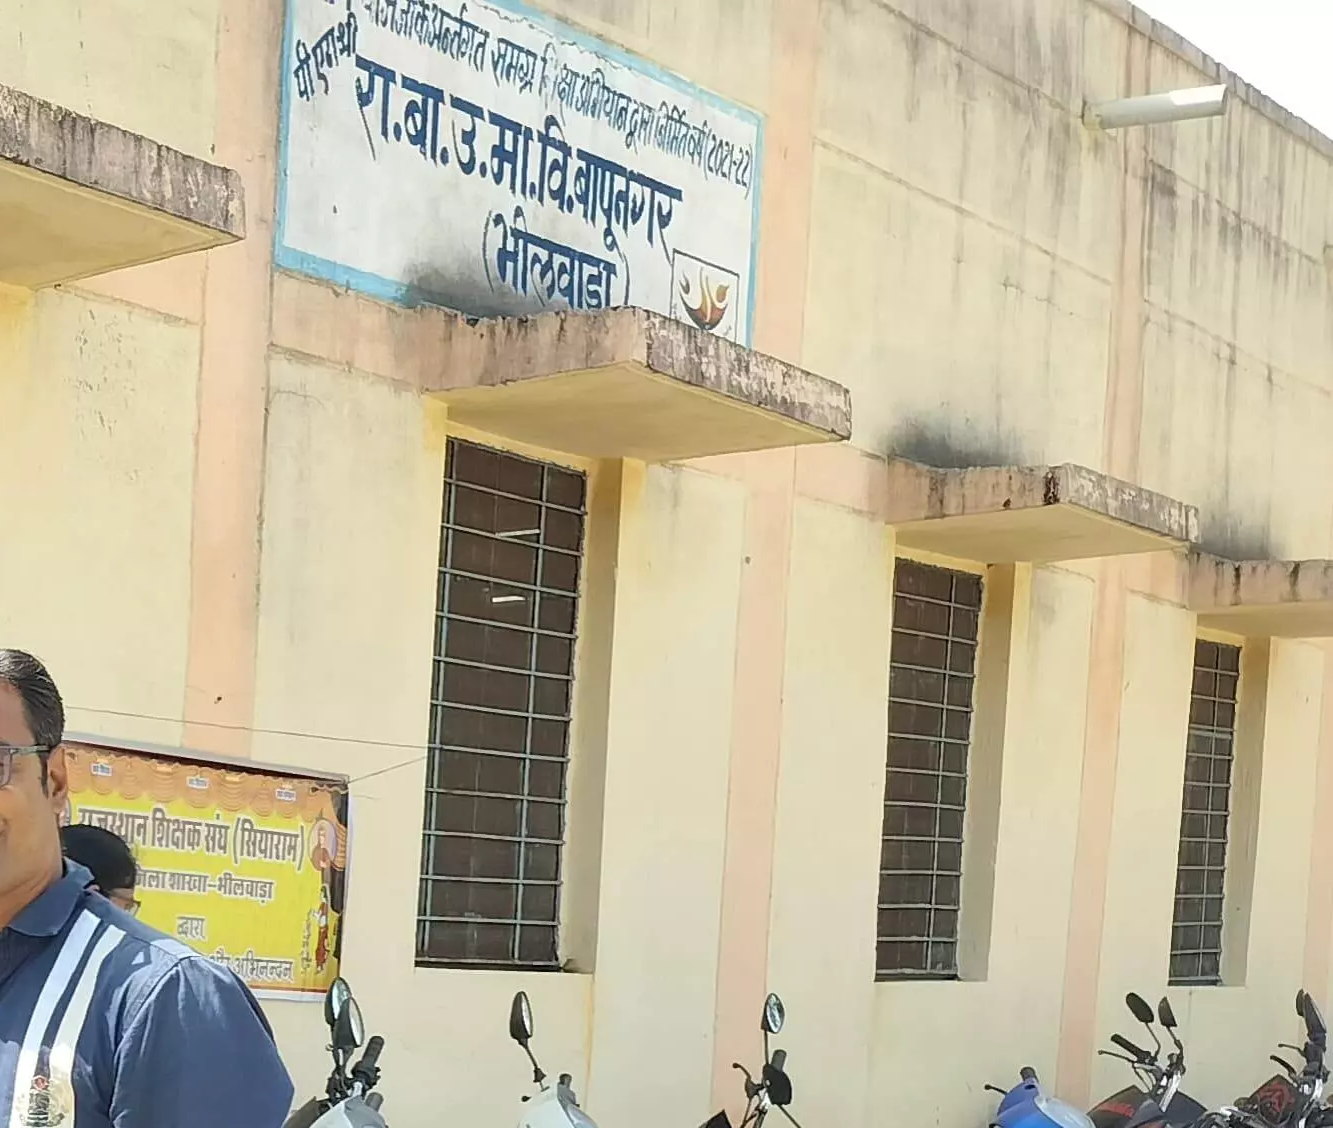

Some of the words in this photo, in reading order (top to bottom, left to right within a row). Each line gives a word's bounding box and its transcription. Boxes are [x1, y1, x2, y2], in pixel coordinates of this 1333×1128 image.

[151, 807, 203, 851] शिक्षक
[204, 813, 230, 855] संघ
[233, 817, 304, 872] (सियाराम)
[235, 950, 294, 981] अभिनन्दन
